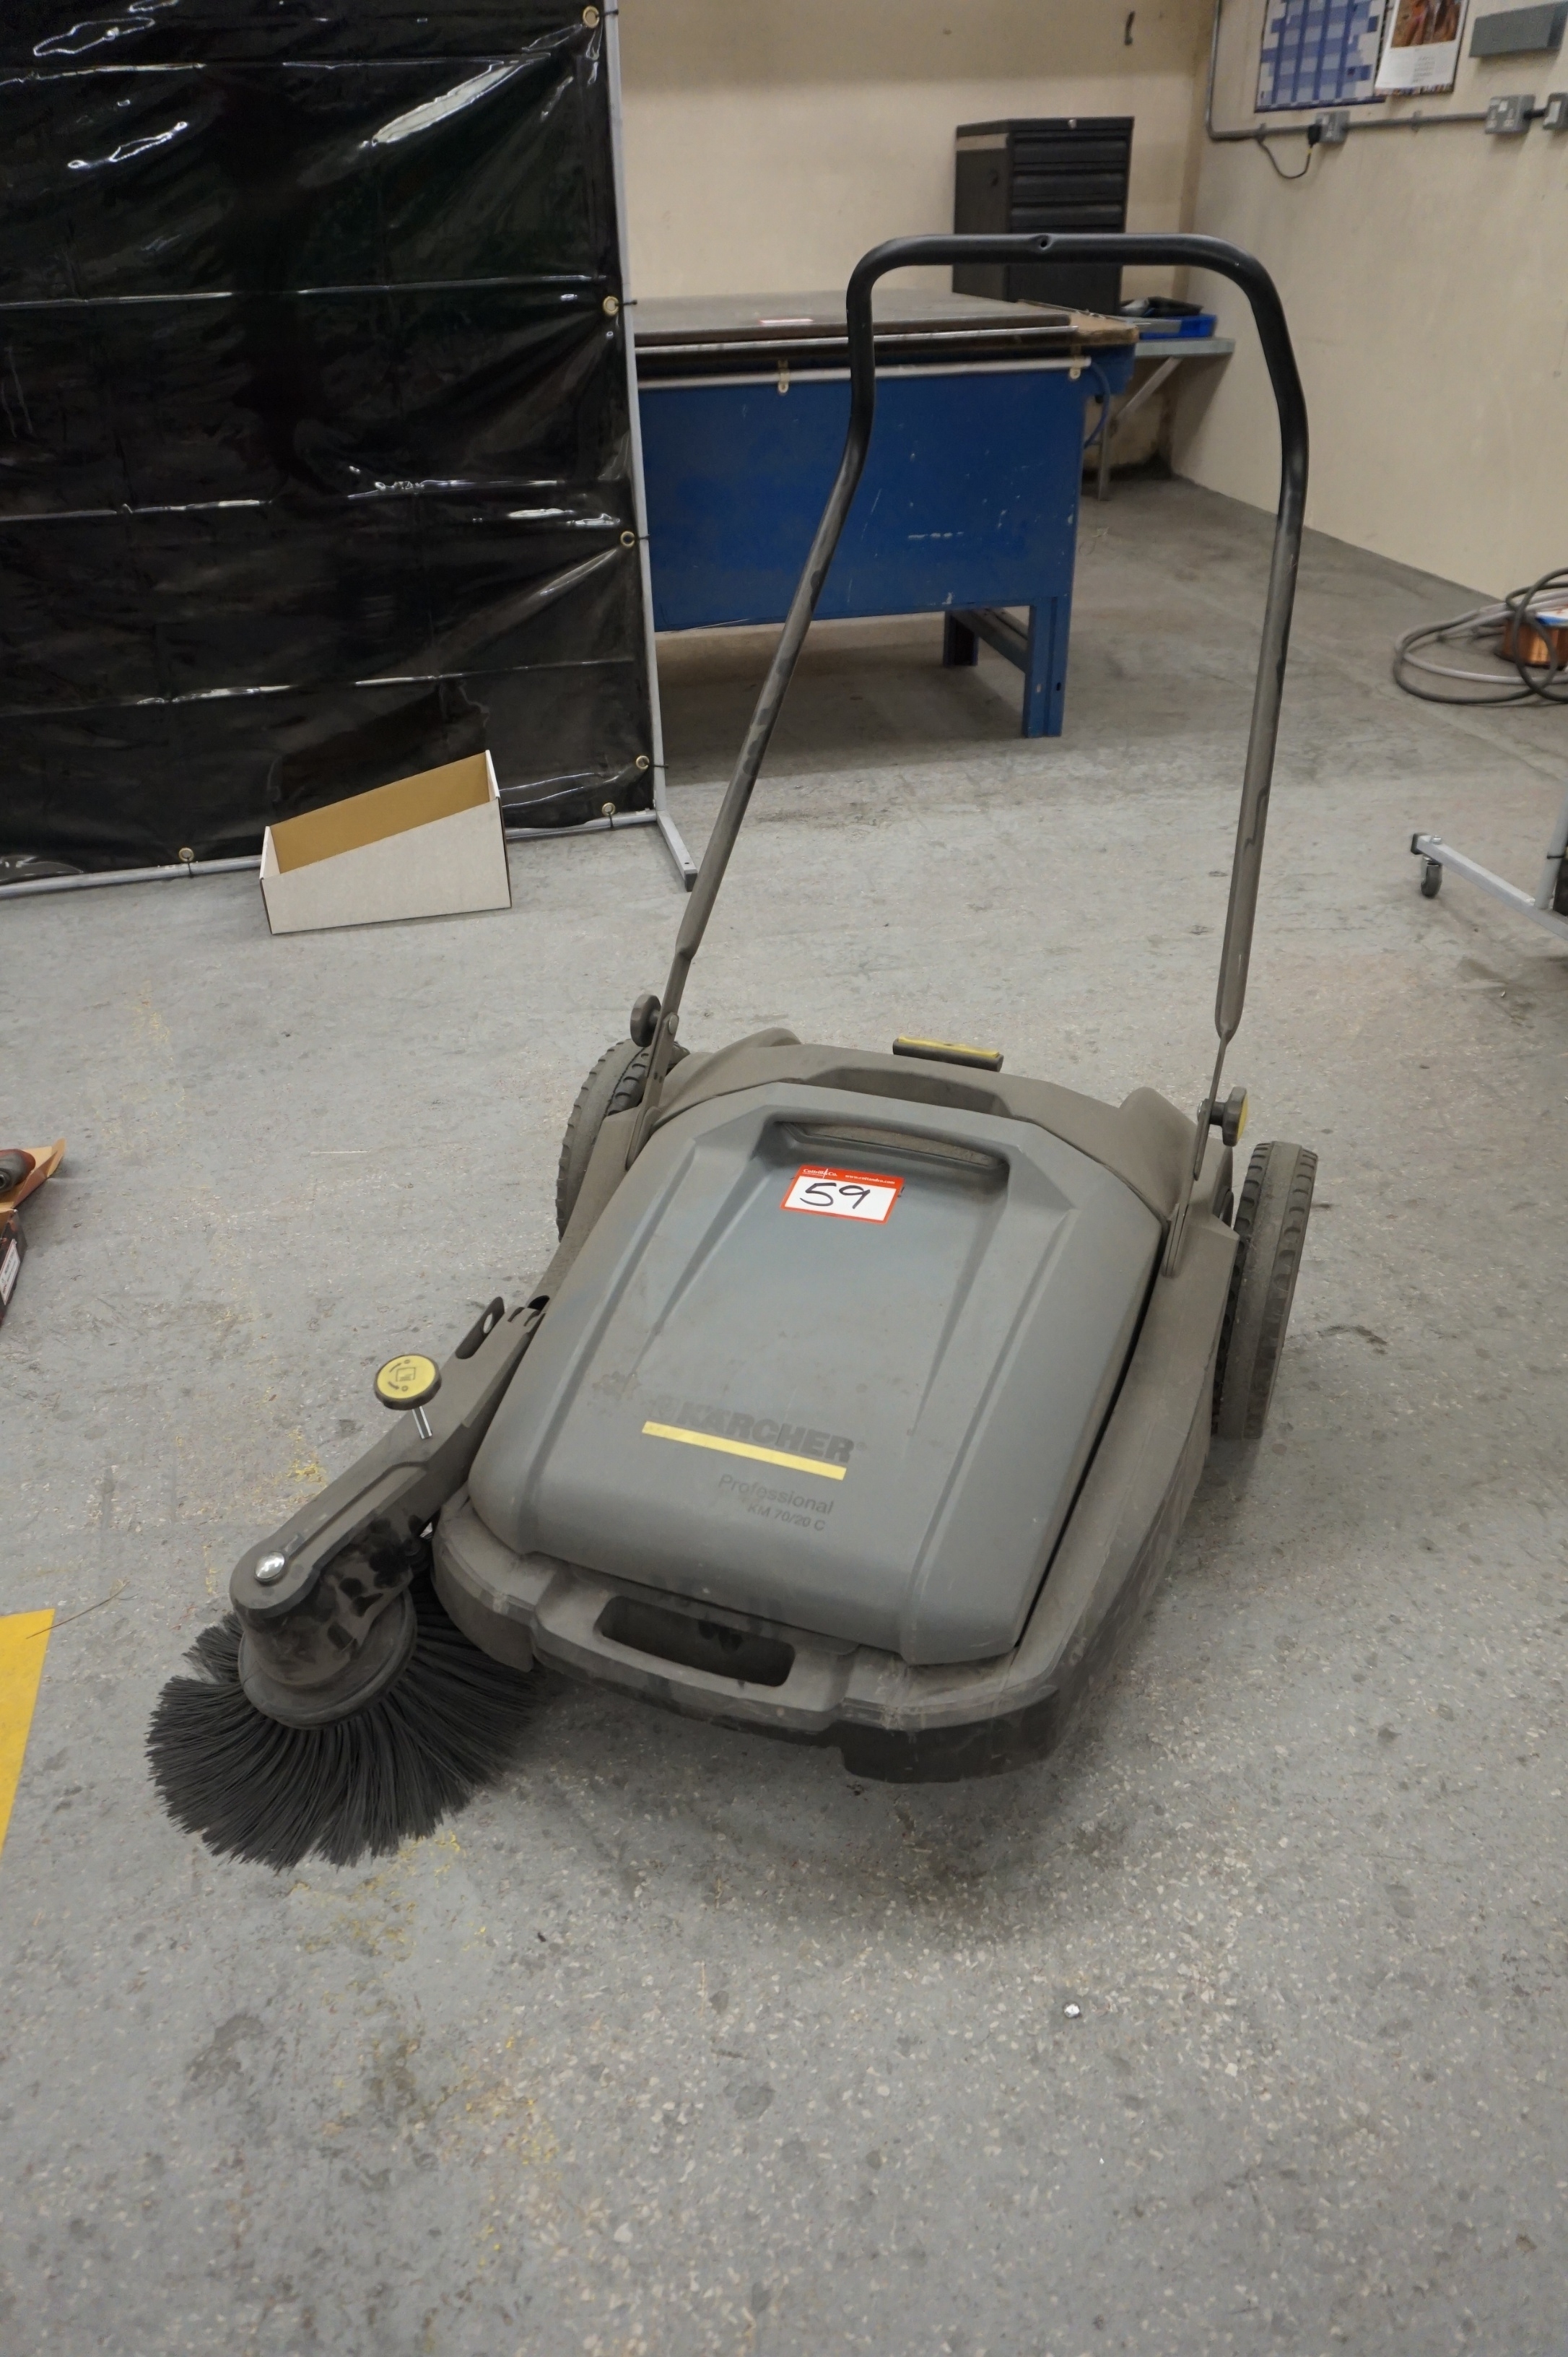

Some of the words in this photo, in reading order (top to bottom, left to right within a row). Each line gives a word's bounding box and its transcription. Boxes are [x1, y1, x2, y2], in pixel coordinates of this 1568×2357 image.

[799, 1182, 871, 1210] 59
[718, 1473, 834, 1514] Professional
[747, 1502, 771, 1518] KM
[774, 1509, 811, 1527] 70/20
[814, 1519, 826, 1532] C
